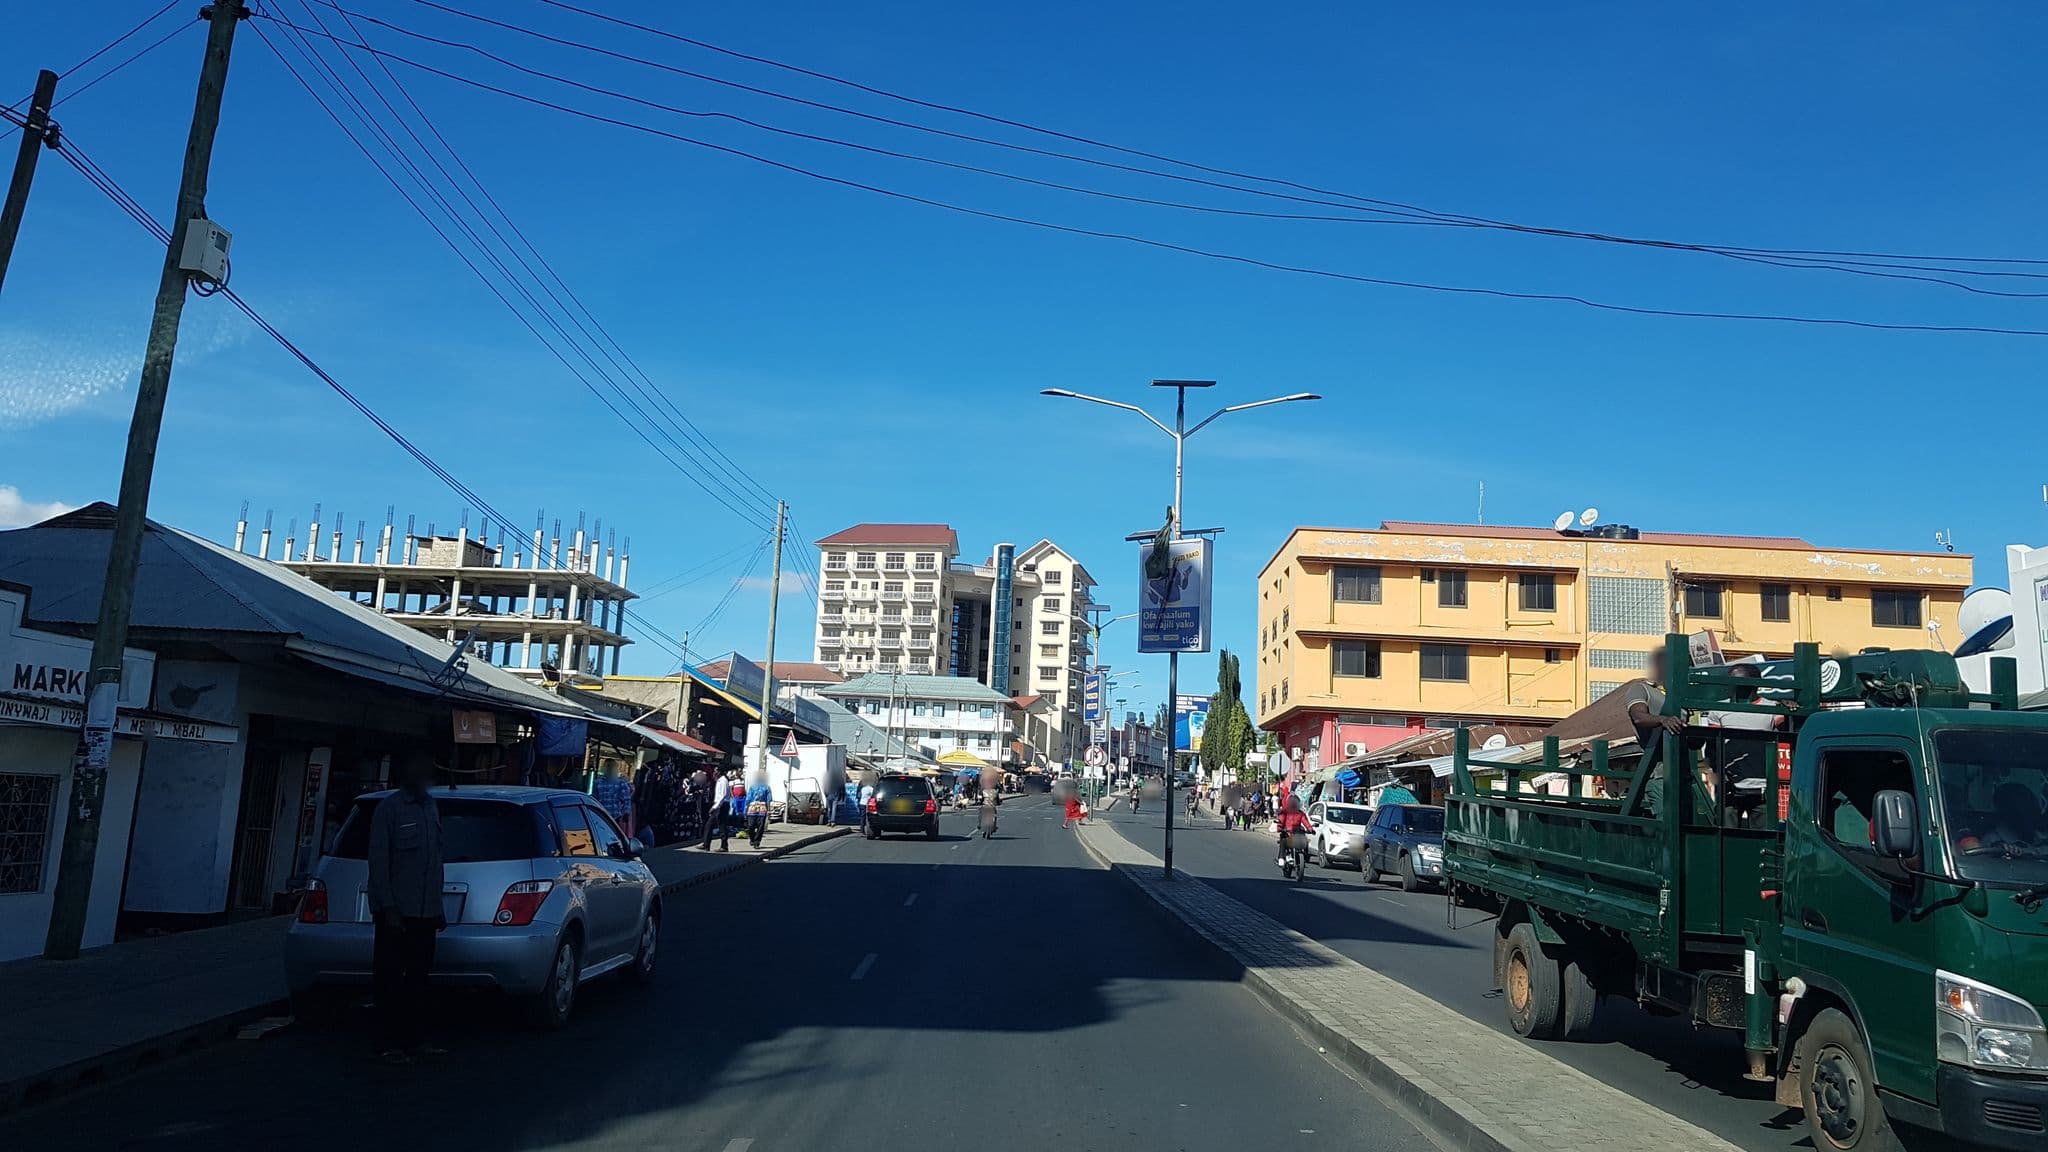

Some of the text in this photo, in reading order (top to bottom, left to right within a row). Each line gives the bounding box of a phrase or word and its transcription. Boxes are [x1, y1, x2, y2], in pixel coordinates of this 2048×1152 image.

[1175, 619, 1195, 630] yako
[1182, 634, 1199, 648] tigo
[61, 710, 82, 725] VYA
[173, 723, 206, 738] MBALI
